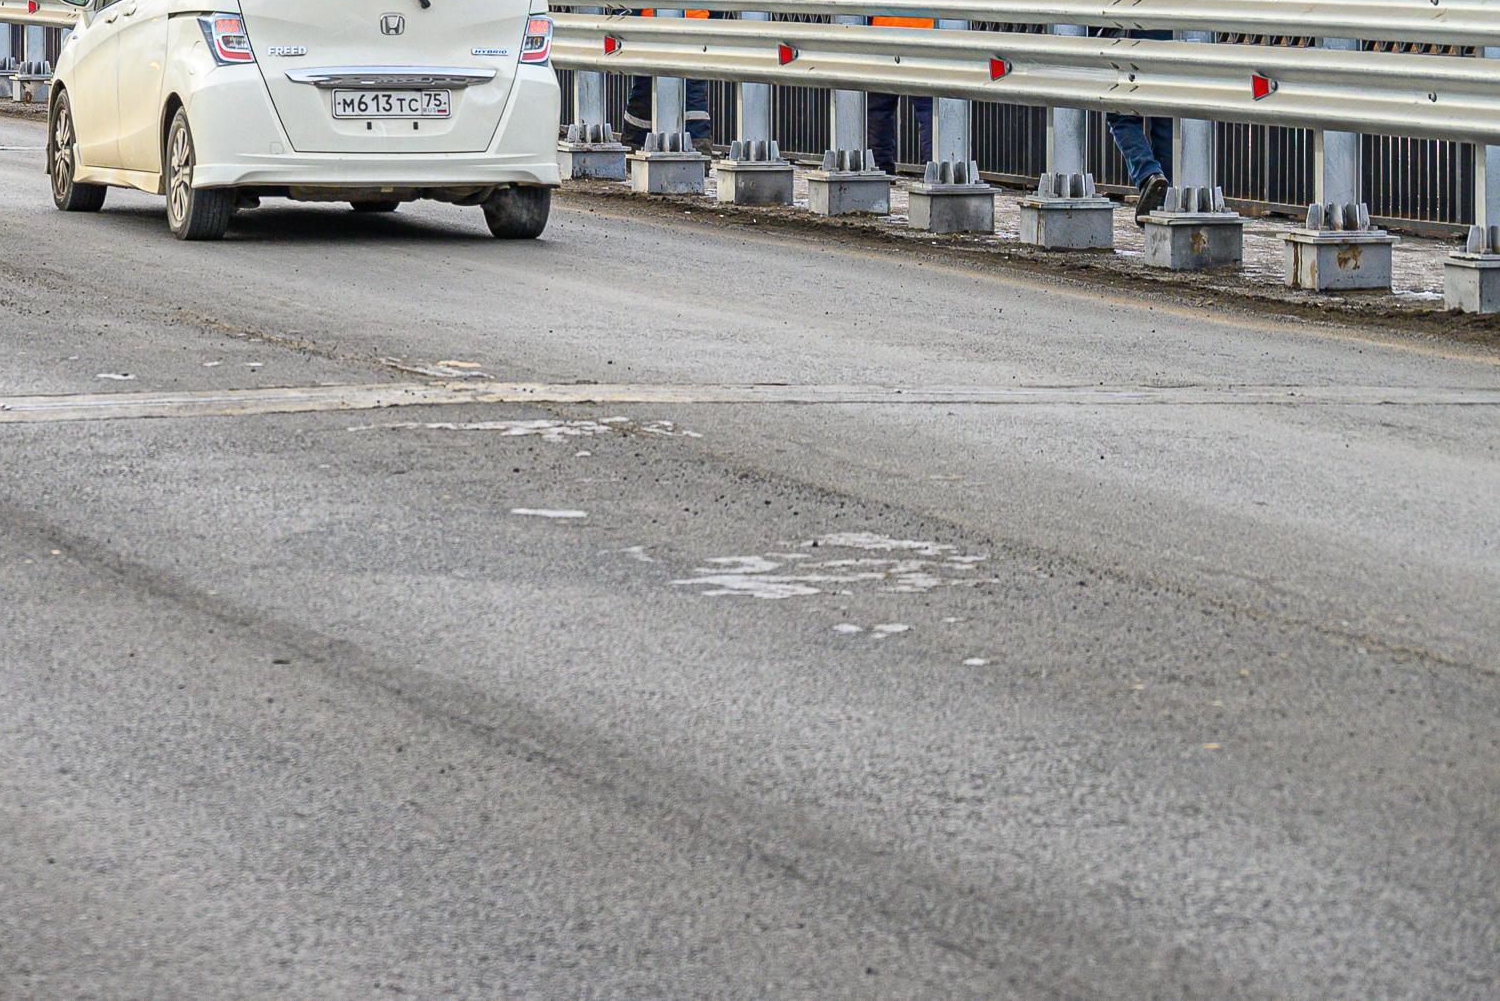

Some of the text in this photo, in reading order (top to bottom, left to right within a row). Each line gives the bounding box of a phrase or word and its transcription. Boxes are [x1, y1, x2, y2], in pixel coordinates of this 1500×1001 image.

[267, 46, 308, 57] FREED
[342, 93, 442, 113] М613ТС 75
